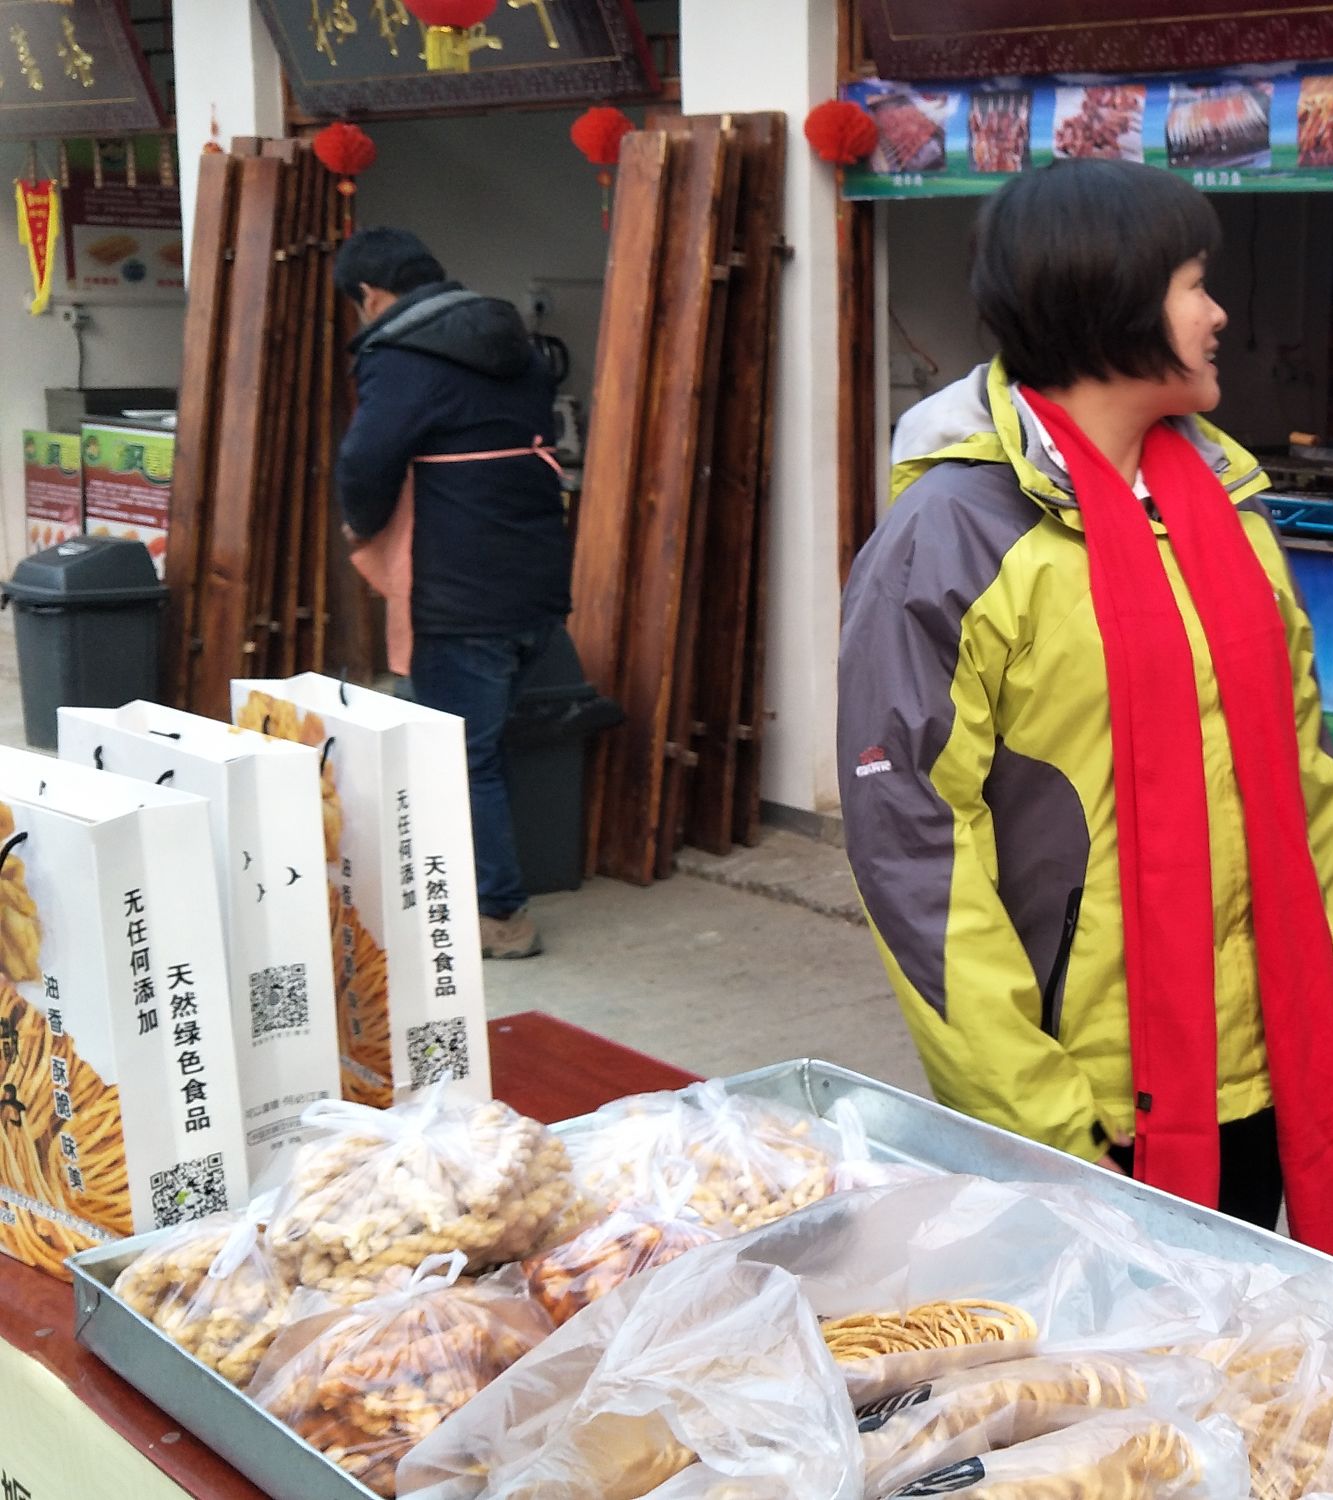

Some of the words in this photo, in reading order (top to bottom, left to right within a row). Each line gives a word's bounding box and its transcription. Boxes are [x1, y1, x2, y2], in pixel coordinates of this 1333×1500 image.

[123, 888, 160, 1037] 无任何添加
[424, 854, 457, 998] 天然绿色食品
[165, 961, 212, 1134] 天然绿色食品
